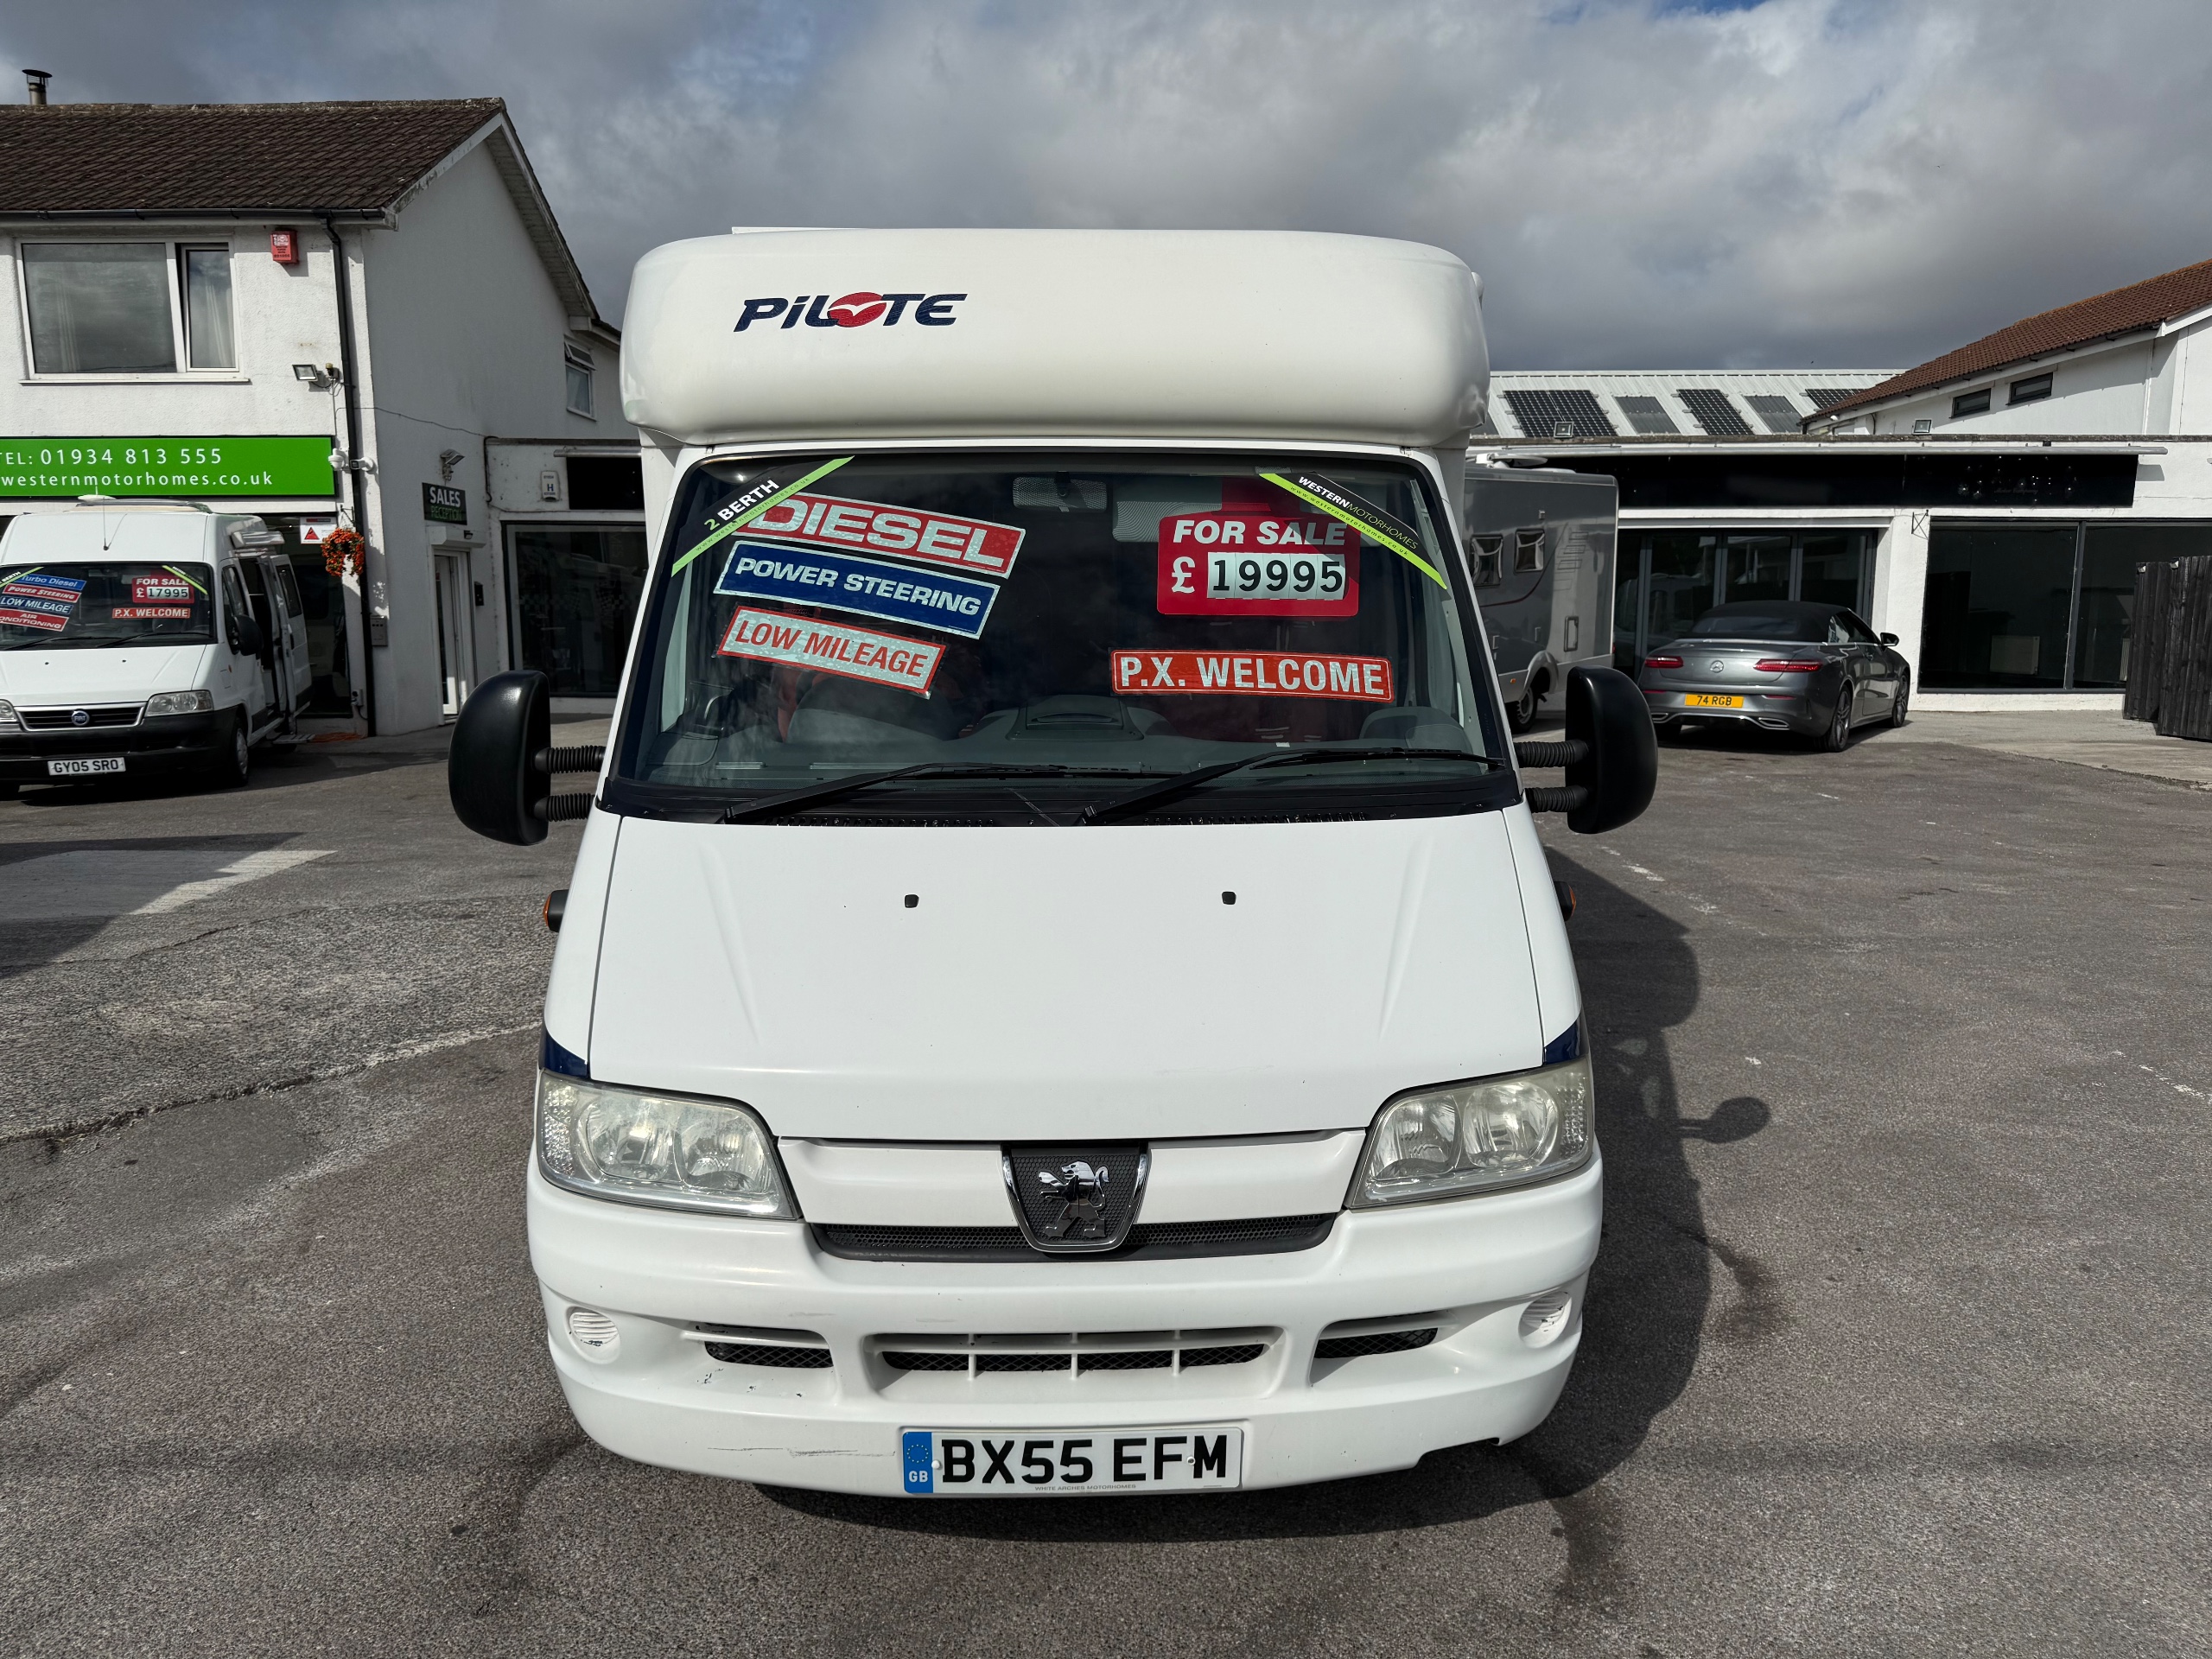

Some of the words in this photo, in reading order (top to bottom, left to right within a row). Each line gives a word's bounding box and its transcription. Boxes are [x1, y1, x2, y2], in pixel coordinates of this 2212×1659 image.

[0, 452, 33, 465] EL:
[41, 448, 113, 465] 01934
[125, 448, 168, 465] 813
[180, 448, 222, 465] 555
[1, 471, 273, 486] westernmotorhomes.co.uk
[429, 486, 461, 508] SALES
[703, 518, 721, 531] 2
[717, 480, 780, 521] BERTH
[747, 499, 1005, 567] DIESEL
[1173, 519, 1245, 545] FOR
[1257, 520, 1348, 545] SALE
[1290, 486, 1409, 556] www.westernmotorhomes.co.uk
[48, 578, 78, 588] Diesel
[735, 556, 840, 588] POWER
[843, 575, 982, 616] STEERING
[1171, 556, 1195, 594] £
[1212, 559, 1344, 593] 19995
[1, 597, 25, 606] LOW
[25, 600, 70, 613] MILEAGE
[148, 588, 188, 598] 17995
[736, 620, 802, 650] LOW
[803, 632, 929, 677] MILEAGE
[1121, 656, 1186, 688] P.X.
[1198, 657, 1384, 696] WELCOME
[1696, 695, 1709, 706] 74
[1712, 696, 1732, 706] RGB
[54, 761, 89, 773] GY05
[92, 760, 119, 771] SRO
[941, 1440, 1094, 1484] BX55
[1112, 1434, 1227, 1481] EFM
[908, 1470, 929, 1483] GB
